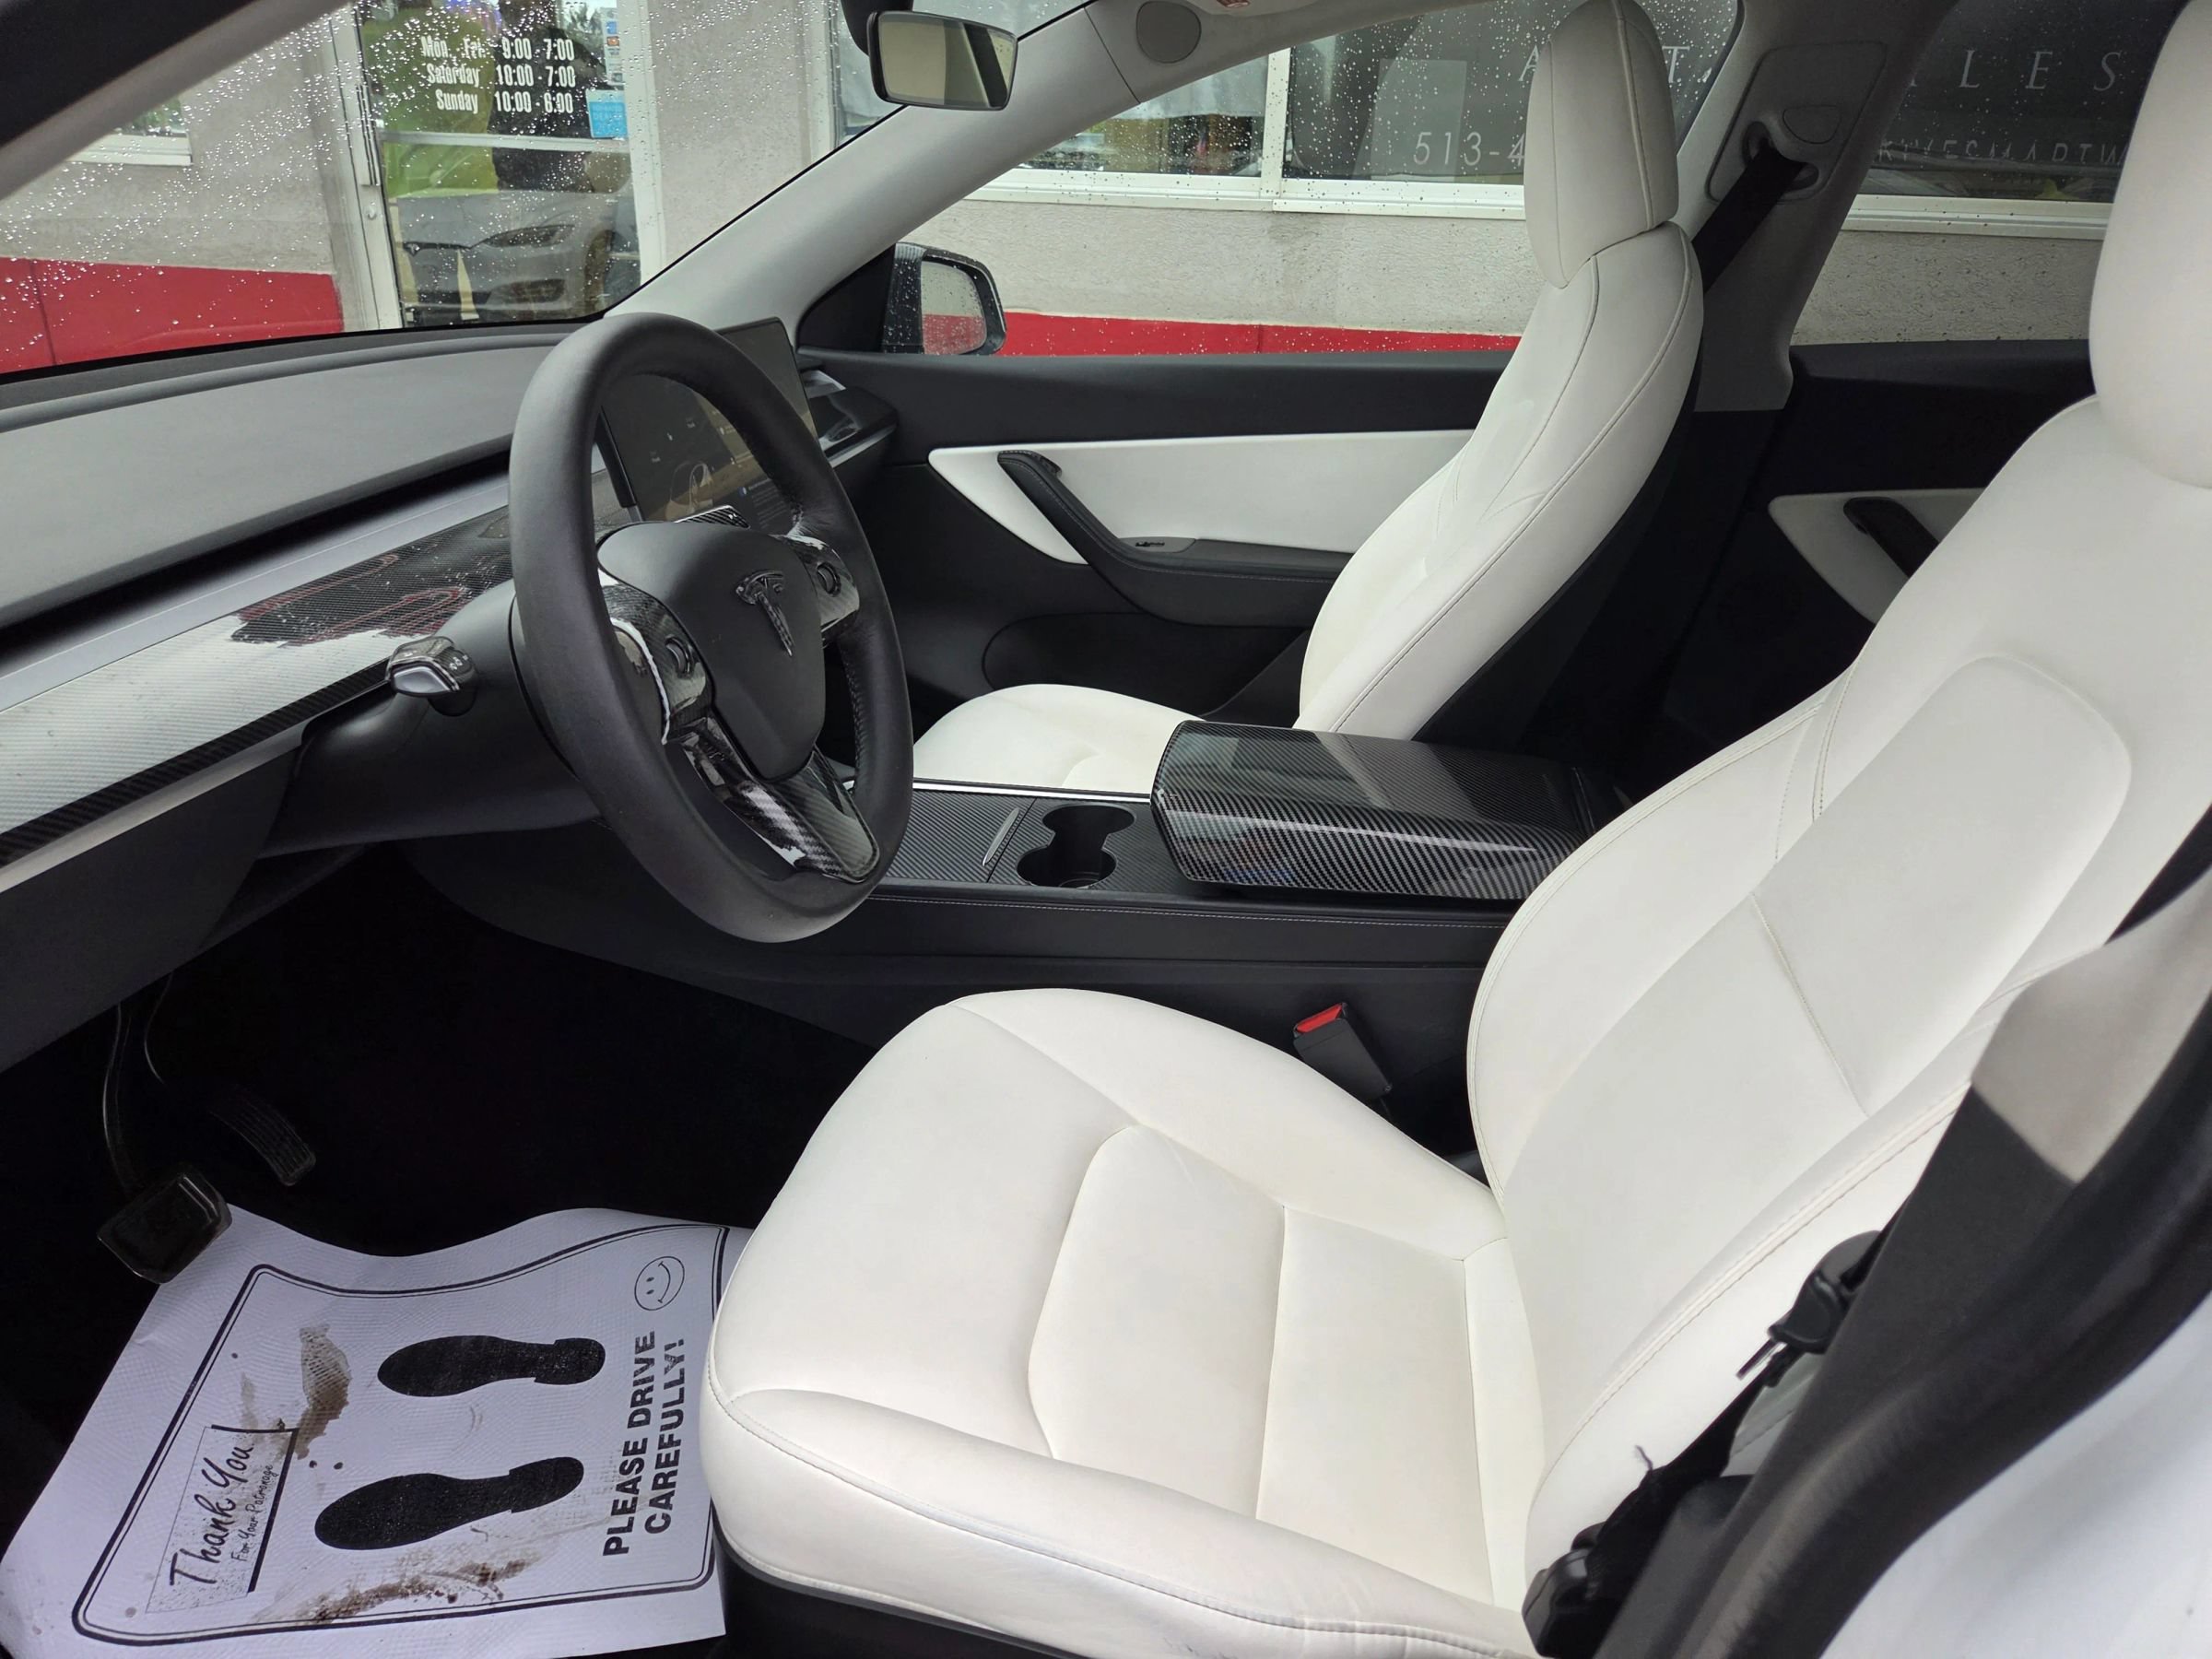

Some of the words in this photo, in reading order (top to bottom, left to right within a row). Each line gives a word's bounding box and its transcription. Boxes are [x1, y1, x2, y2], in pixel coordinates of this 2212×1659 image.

[501, 36, 532, 60] 9:00
[544, 38, 574, 61] 7:00
[427, 63, 480, 88] Saturday
[496, 64, 534, 86] 10:00
[546, 65, 576, 87] 7:00
[435, 89, 478, 114] Sunday
[495, 90, 532, 112] 10:00
[544, 92, 573, 113] 6:00
[602, 1437, 648, 1556] PLEASE
[627, 1330, 655, 1430] DRIVE
[645, 1338, 686, 1535] CAREFULLY!
[245, 1464, 280, 1514] Patronage
[170, 1493, 237, 1586] Thank
[238, 1516, 259, 1540] Your
[230, 1542, 253, 1562] For
